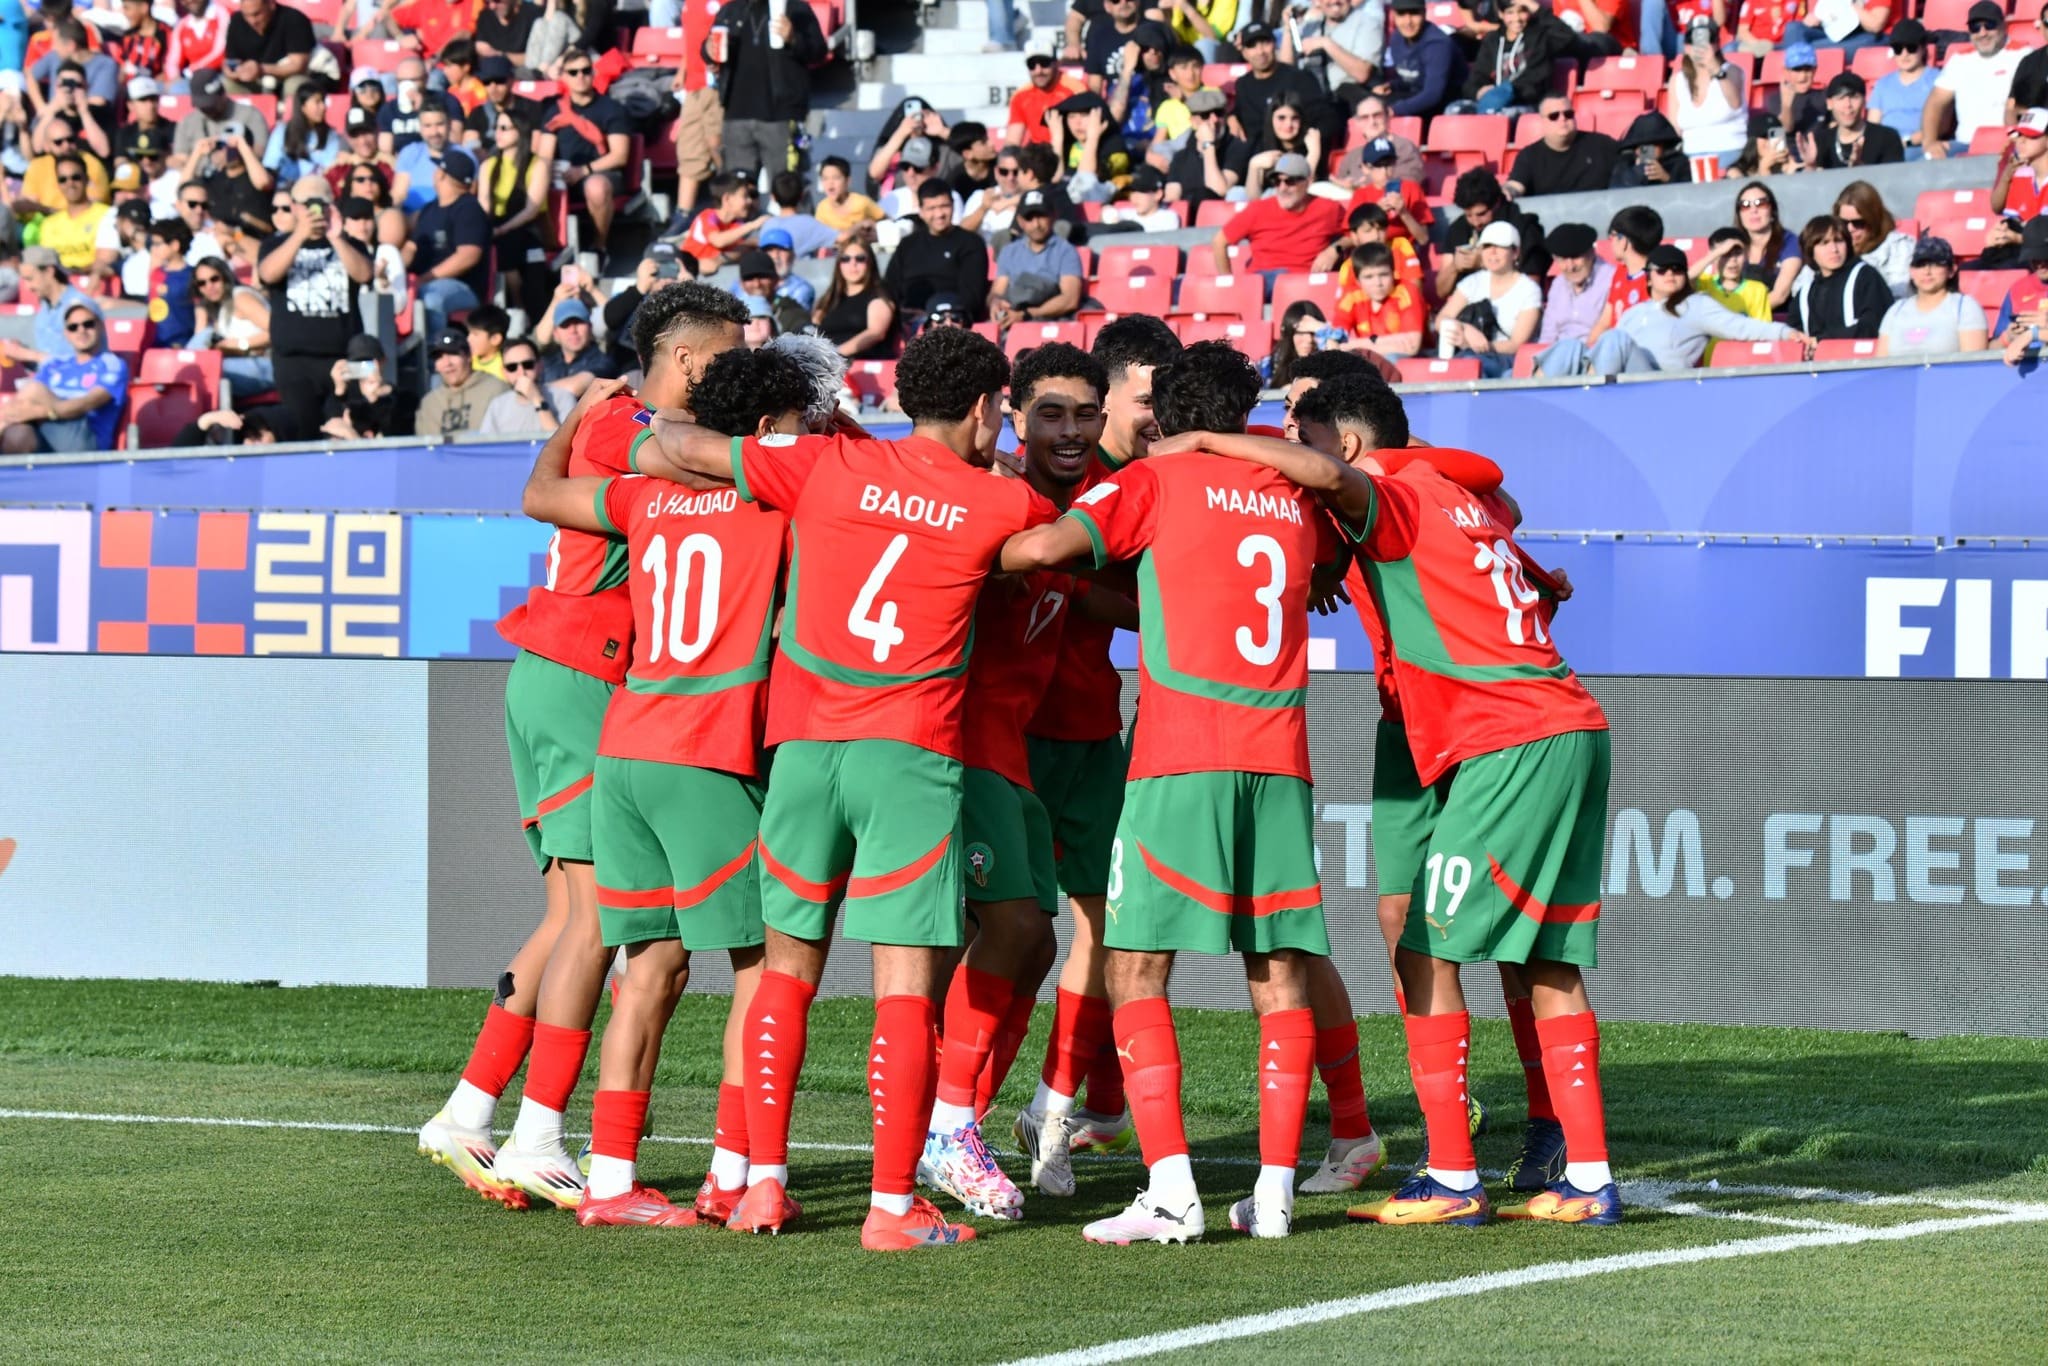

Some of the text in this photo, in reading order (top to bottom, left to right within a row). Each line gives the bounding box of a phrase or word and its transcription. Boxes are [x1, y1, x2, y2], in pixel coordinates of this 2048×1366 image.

[859, 484, 968, 531] BAOUF
[1205, 486, 1303, 526] MAAMAR
[641, 533, 722, 663] 10
[847, 533, 909, 663] 4
[1235, 534, 1286, 666] 3
[1107, 838, 1123, 900] 3
[1425, 852, 1472, 917] 19
[1600, 808, 1735, 898] M.
